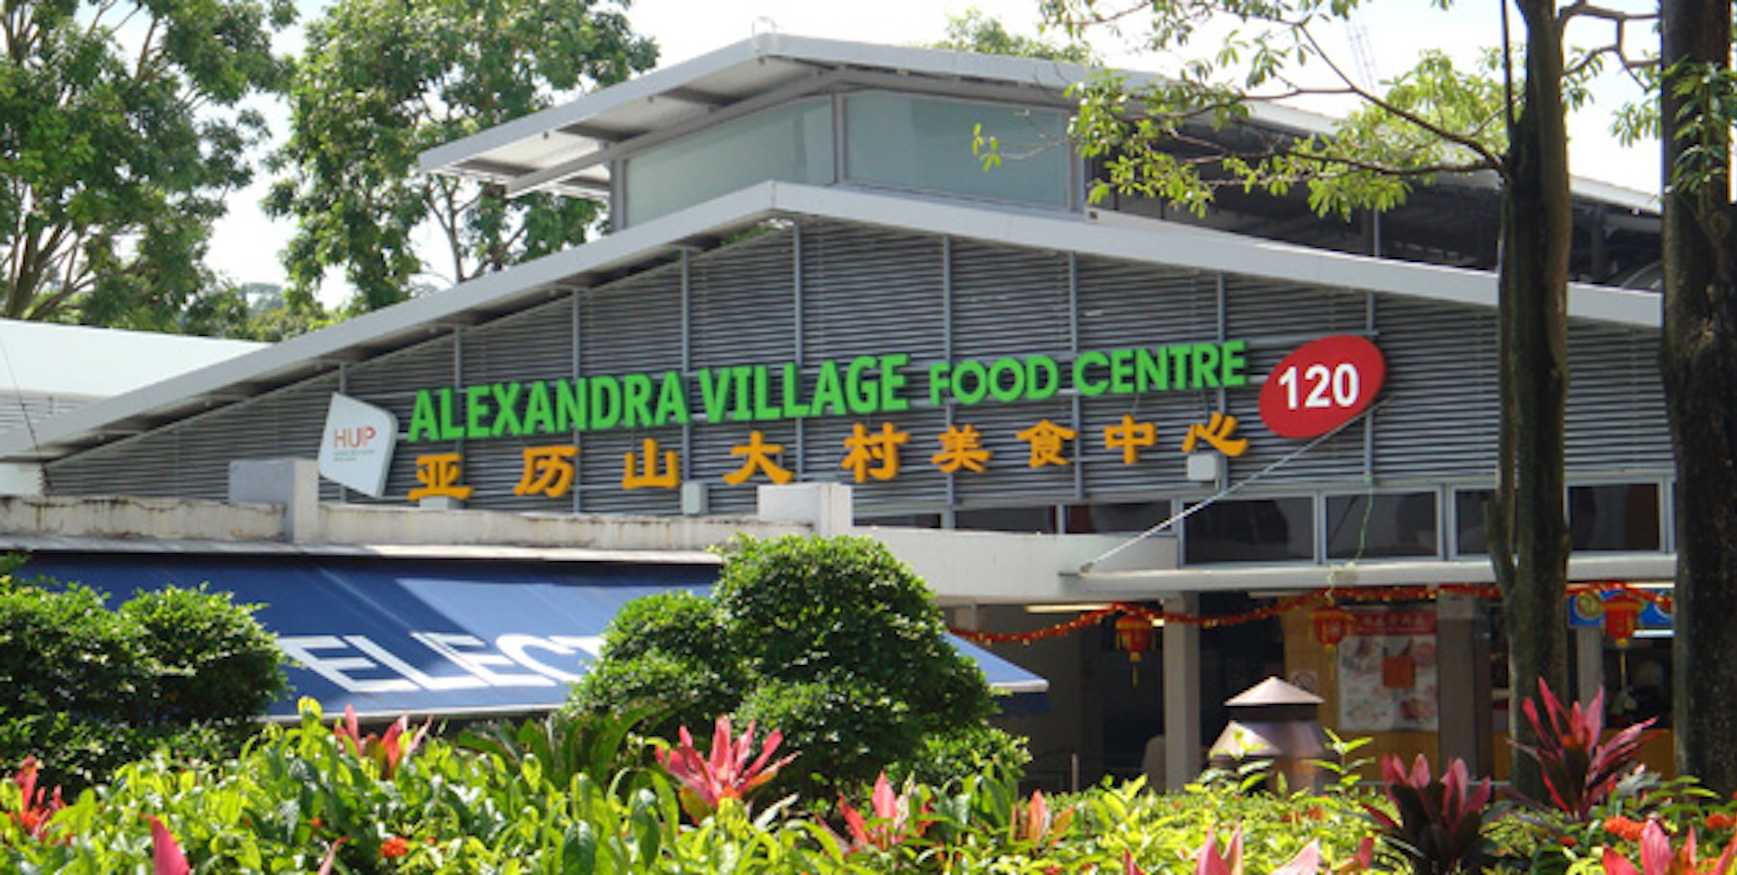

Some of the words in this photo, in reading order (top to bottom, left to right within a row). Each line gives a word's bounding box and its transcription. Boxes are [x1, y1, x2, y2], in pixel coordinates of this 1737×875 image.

[407, 370, 692, 442] ALEXANDRA
[699, 354, 910, 424] VILLAGE
[928, 356, 1059, 406] FOOD
[1071, 341, 1247, 397] CENTRE
[1278, 362, 1360, 410] 120
[333, 426, 377, 449] HUP
[407, 412, 1249, 502] 亚历山大村美食中心
